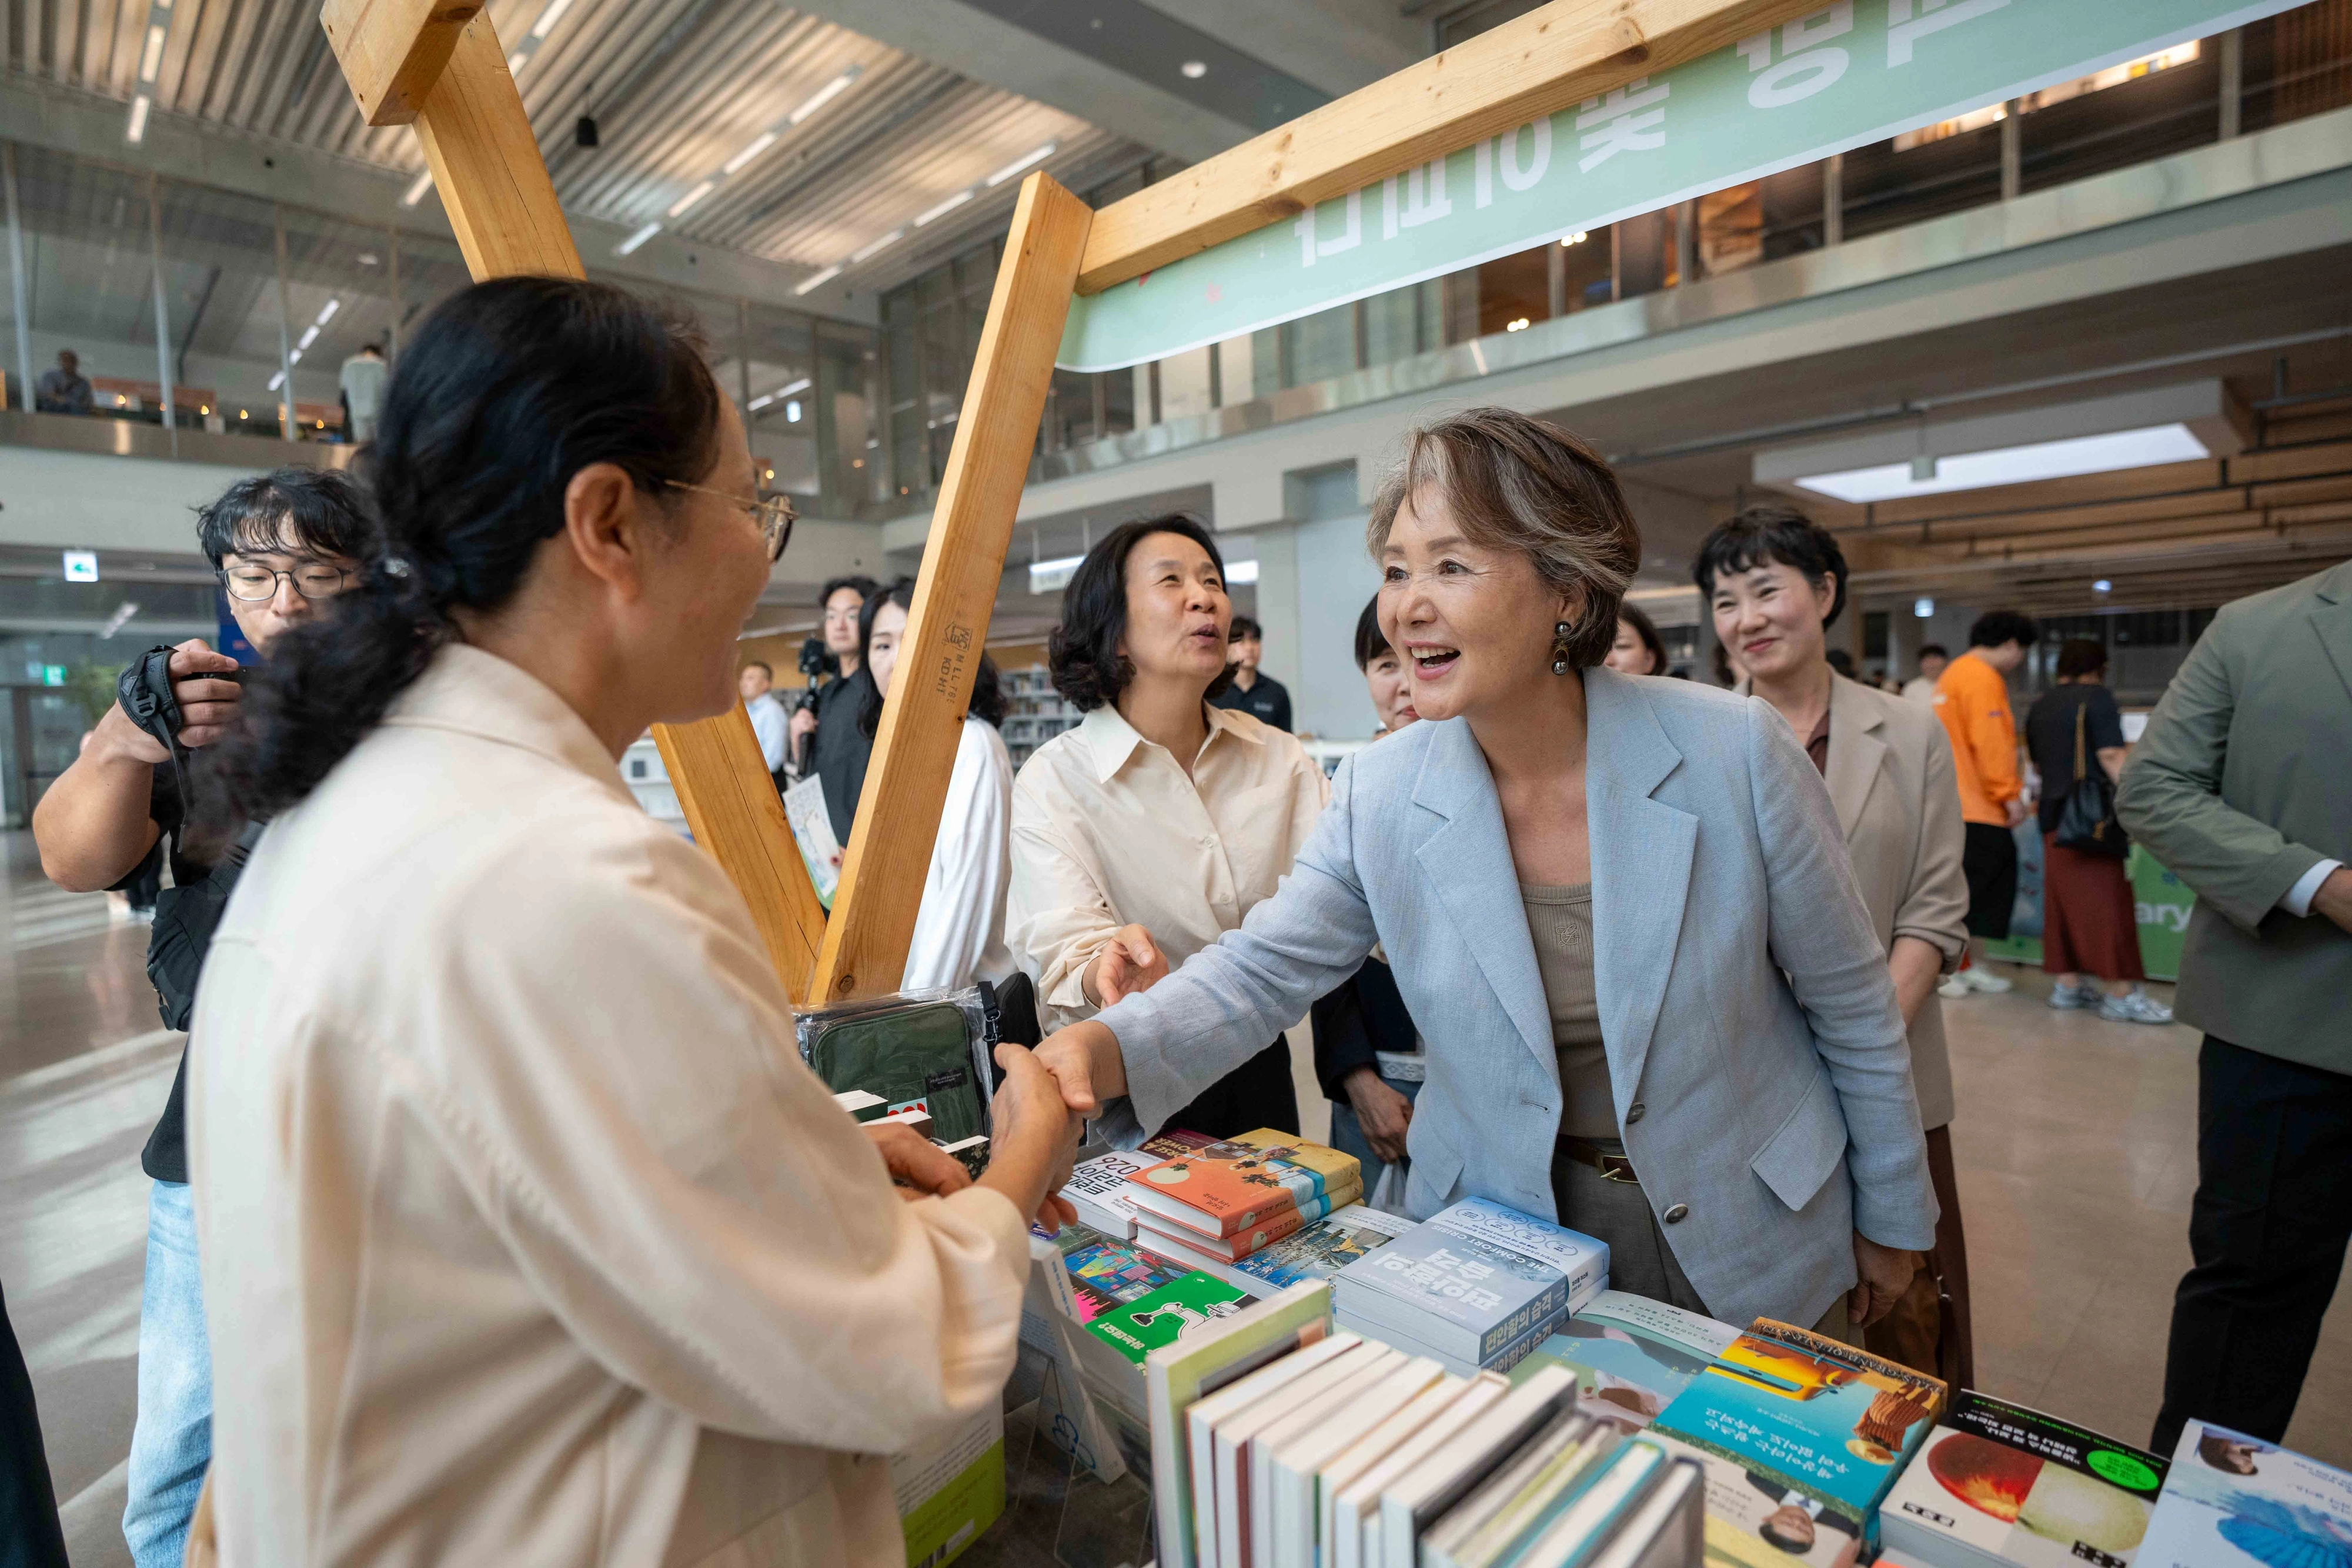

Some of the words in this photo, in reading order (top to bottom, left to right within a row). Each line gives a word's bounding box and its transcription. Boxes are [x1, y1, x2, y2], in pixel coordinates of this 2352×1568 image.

[1074, 1165, 1131, 1187] 코리아
[1095, 1158, 1141, 1175] 026
[1430, 1224, 1468, 1240] CRISIS
[1465, 1238, 1529, 1263] COMFORT
[1424, 1249, 1495, 1281] 습격
[1525, 1261, 1551, 1272] THE
[1371, 1252, 1502, 1311] 편안함의
[1098, 1322, 1145, 1350] 하는데요?
[1485, 1307, 1529, 1354] 편안함의
[1532, 1292, 1552, 1322] 습격
[1755, 1439, 1835, 1479] 세상이라는
